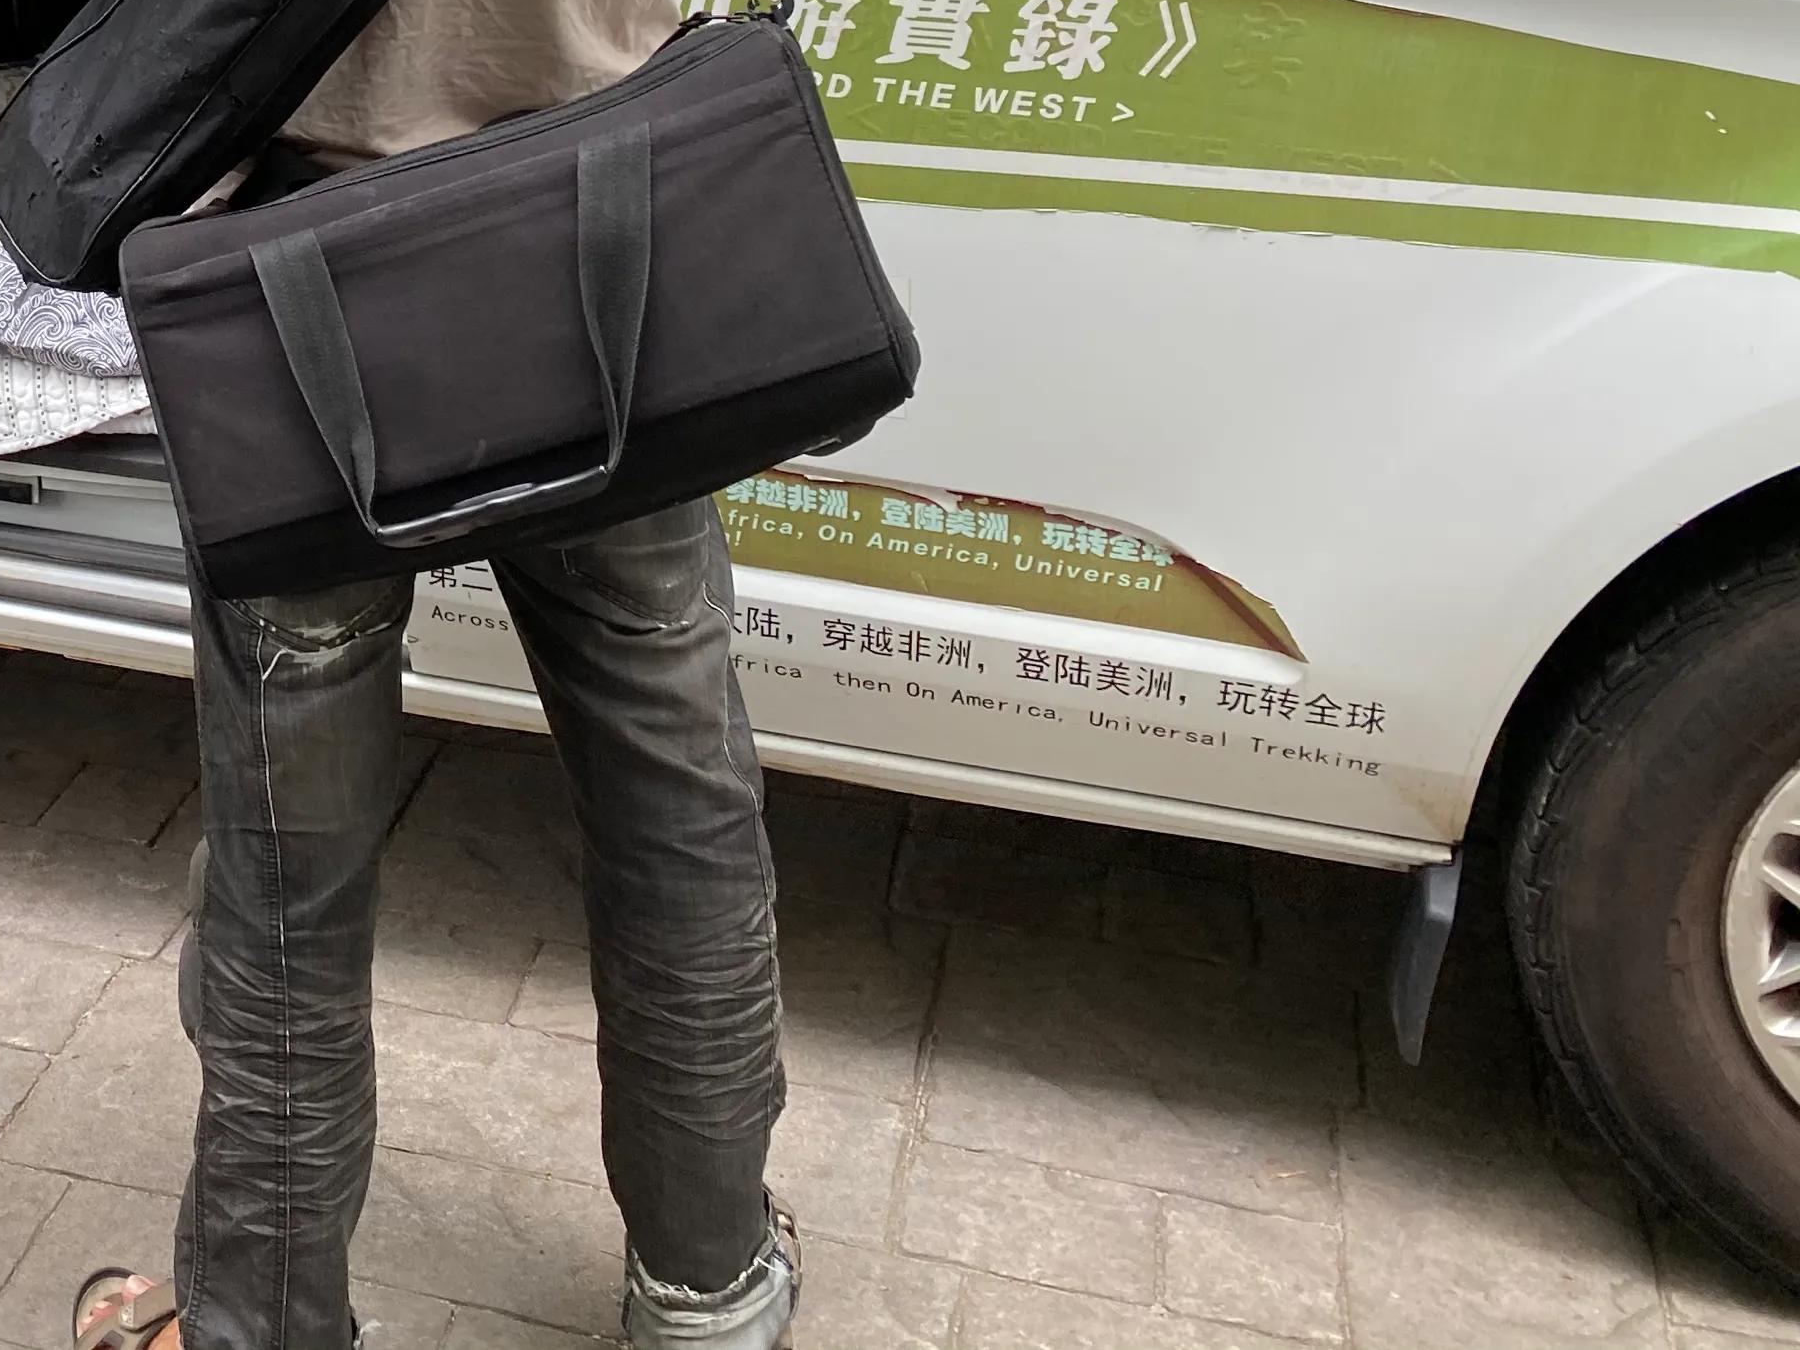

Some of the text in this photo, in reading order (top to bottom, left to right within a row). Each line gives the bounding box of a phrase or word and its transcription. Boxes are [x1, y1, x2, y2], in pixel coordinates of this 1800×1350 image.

[872, 76, 956, 110] THE
[973, 87, 1097, 124] WEST
[818, 525, 853, 545] On
[866, 532, 1000, 571] America,
[1014, 553, 1164, 592] Universal
[431, 605, 509, 631] Across
[833, 671, 891, 694] then
[906, 681, 936, 701] On
[1089, 710, 1227, 748] Universal
[1251, 736, 1382, 777] Trekking
